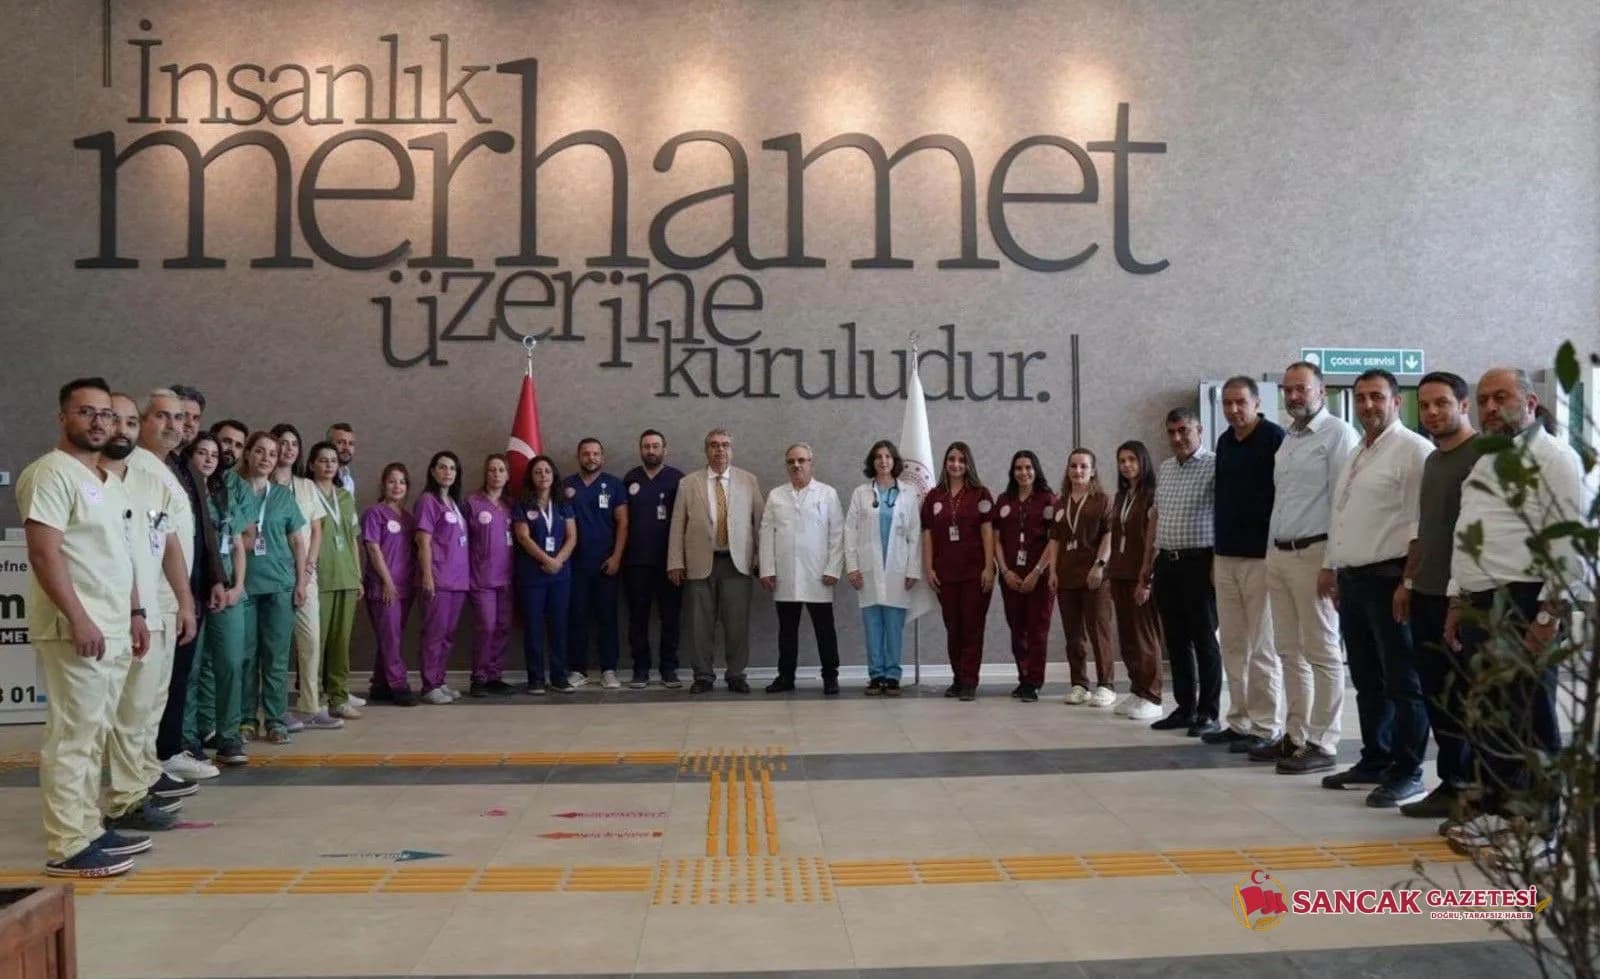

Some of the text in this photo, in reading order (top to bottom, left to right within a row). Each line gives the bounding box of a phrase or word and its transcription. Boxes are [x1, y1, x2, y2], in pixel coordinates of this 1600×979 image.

[127, 19, 492, 126] İnsanlık
[74, 58, 1170, 275] merhamet
[371, 269, 764, 369] üzerine
[654, 320, 1051, 403] kuruludur.
[1330, 356, 1361, 368] ÇOCUK
